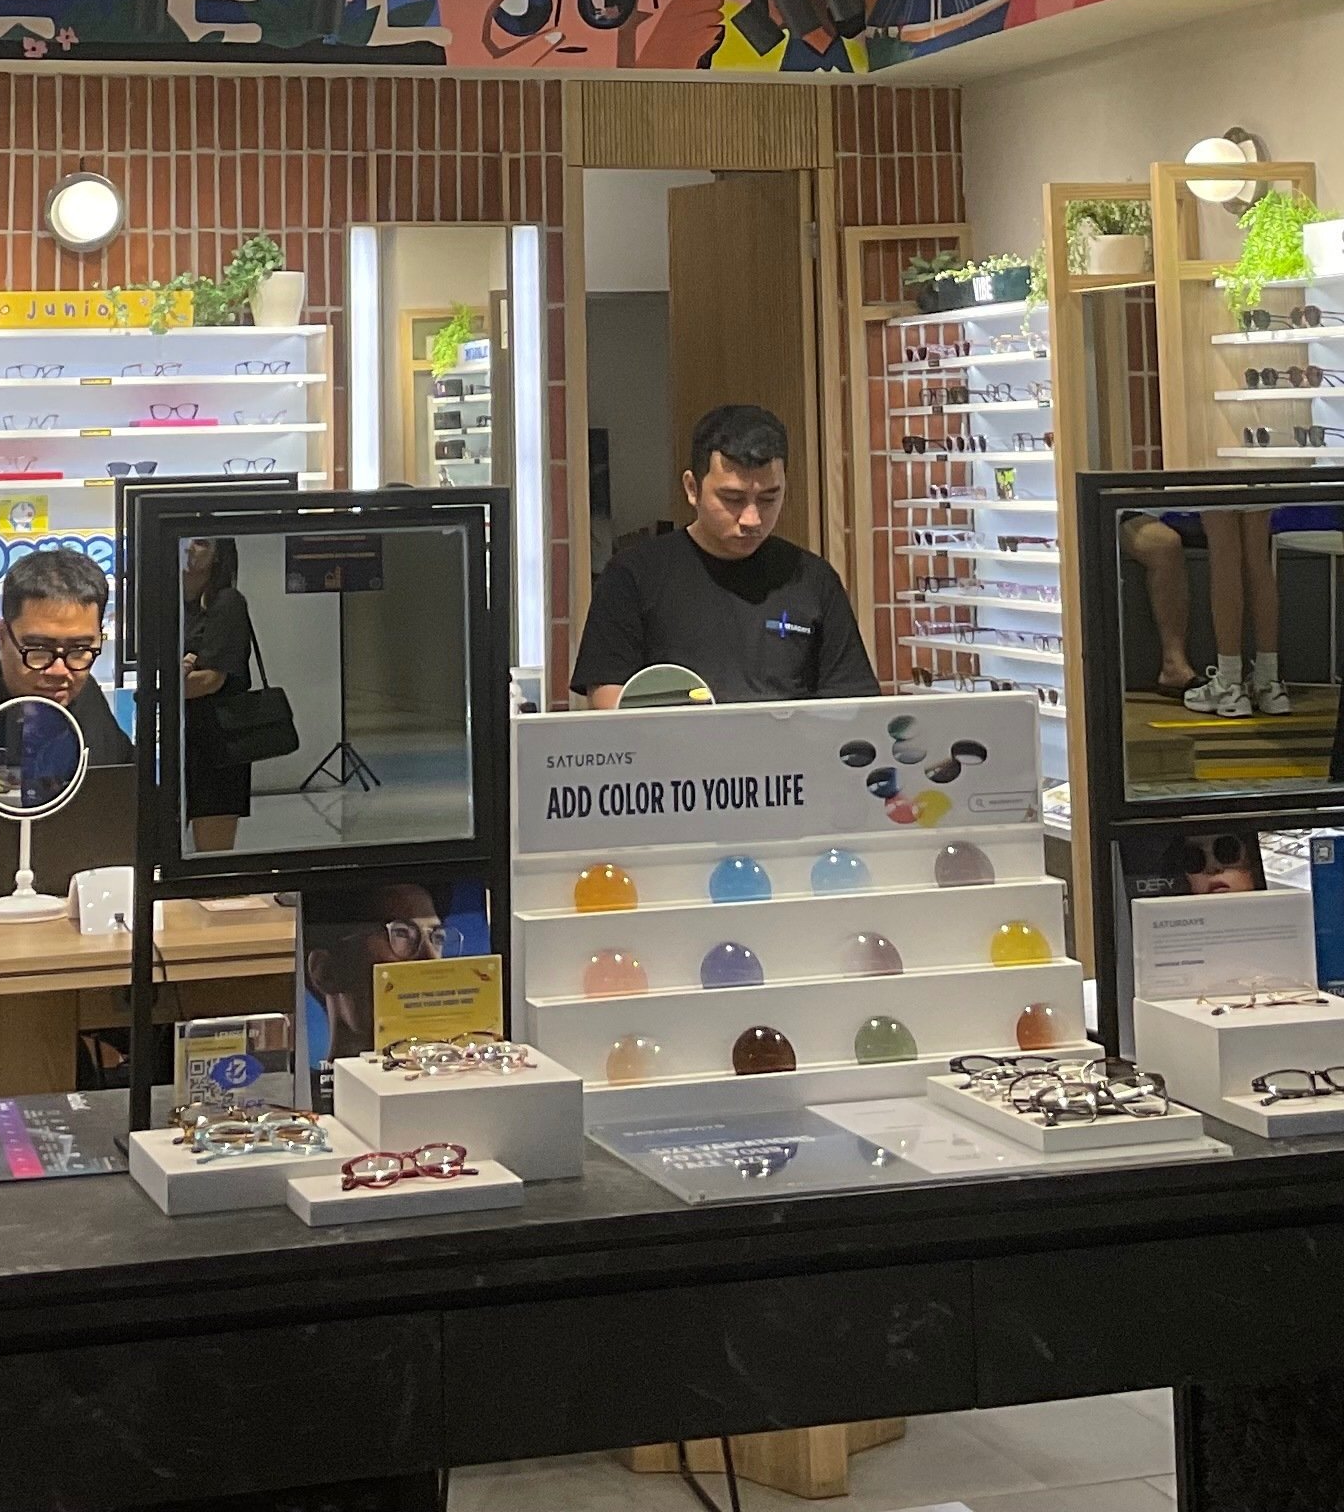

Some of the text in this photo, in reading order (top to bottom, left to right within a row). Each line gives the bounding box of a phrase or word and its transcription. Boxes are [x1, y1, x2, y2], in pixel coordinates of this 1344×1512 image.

[546, 752, 634, 769] SATURDAYS
[546, 773, 804, 819] ADD COLOR TO YOUR LIFE
